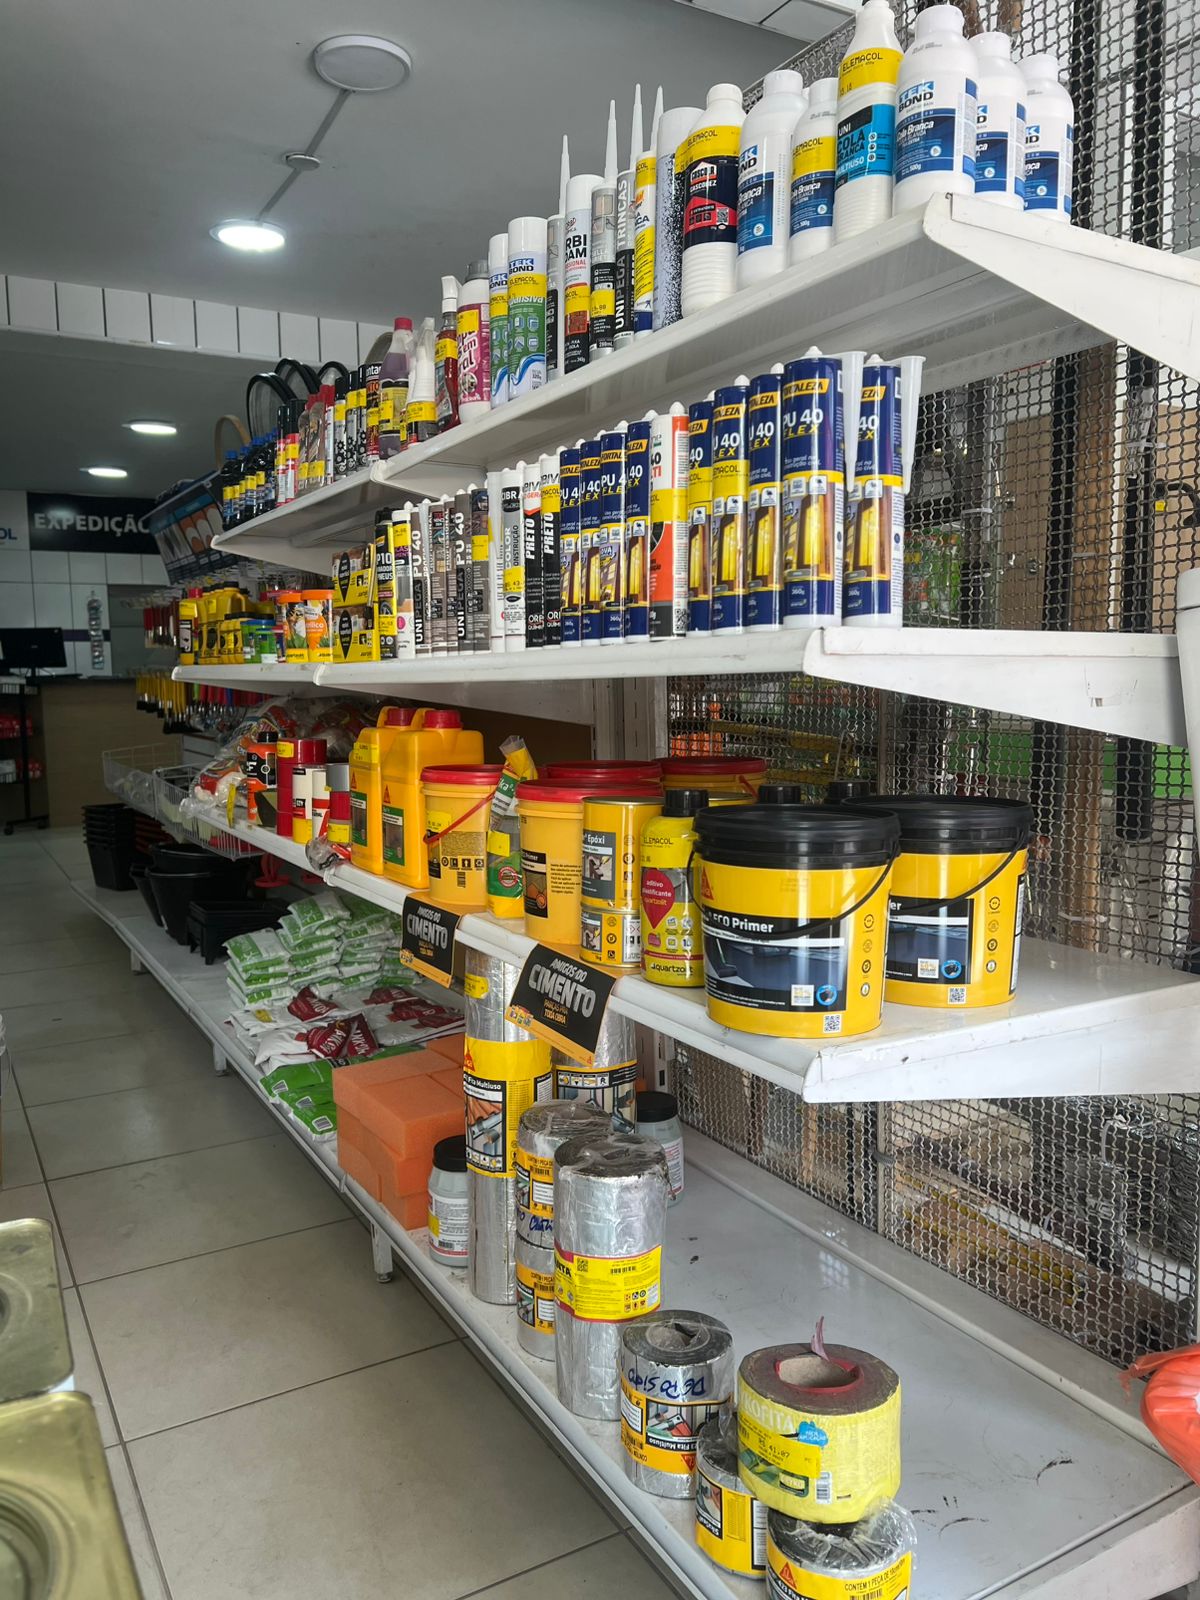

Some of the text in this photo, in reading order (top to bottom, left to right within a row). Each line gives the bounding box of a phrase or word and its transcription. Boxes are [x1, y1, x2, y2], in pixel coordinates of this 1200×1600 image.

[900, 81, 935, 104] TEK
[898, 91, 935, 113] BOND
[907, 120, 935, 136] Branca
[615, 179, 628, 330] UNIPEGA TRINCAS
[508, 264, 535, 276] BOND
[800, 408, 824, 425] 40
[756, 421, 775, 438] 40
[720, 432, 741, 449] 40
[629, 464, 644, 479] 40
[601, 473, 616, 488] PU
[33, 512, 150, 537] EXPEDIÇÃO
[525, 518, 536, 560] PRETO
[543, 512, 555, 555] PRETO
[454, 511, 466, 637] UNIPEGA PU 40
[411, 530, 423, 642] UNIPEGA PU 40
[587, 834, 605, 846] Epóxi
[645, 880, 665, 889] aditivo
[416, 906, 436, 921] AMIGOS
[406, 913, 449, 950] CIMENTO
[731, 917, 775, 934] Primer
[550, 957, 577, 978] AMIGOS
[655, 962, 694, 974] quartzot
[527, 963, 597, 1019] CIMENTO
[476, 1079, 502, 1091] Multiuso
[648, 1437, 691, 1451] Fita Multiuso
[871, 1576, 884, 1588] PEÇA
